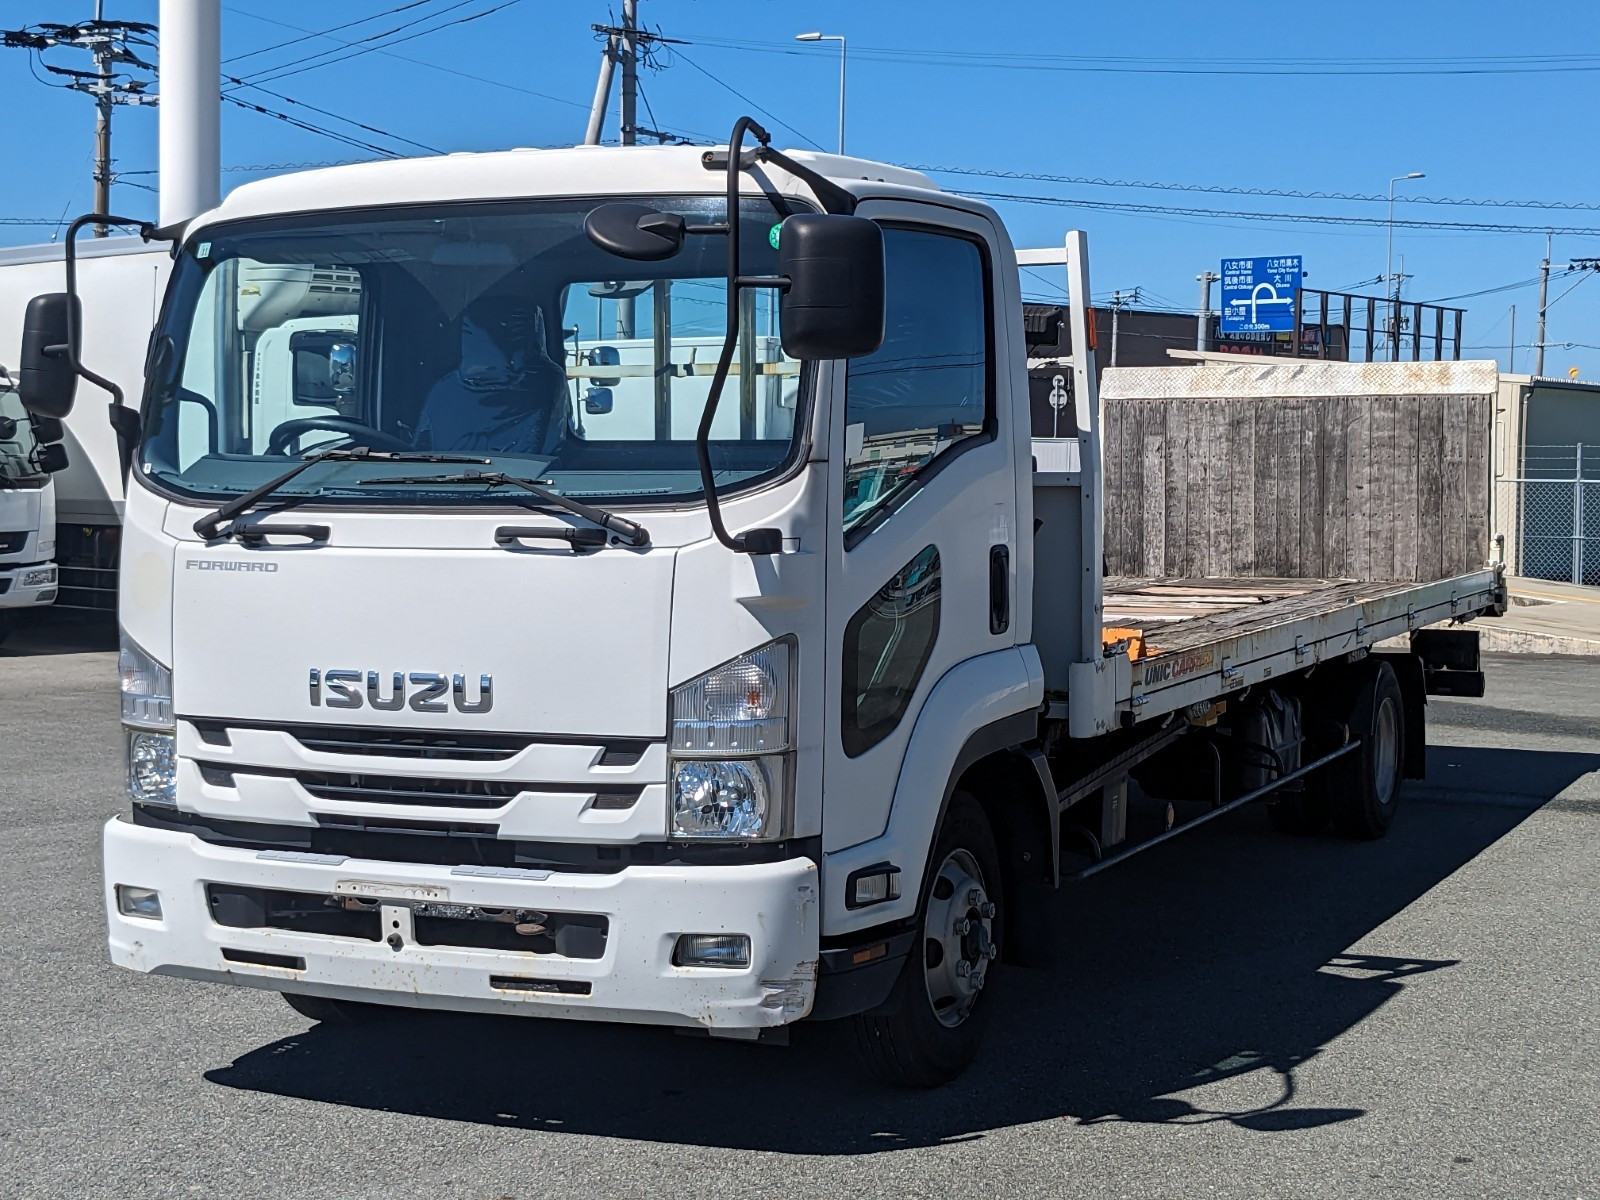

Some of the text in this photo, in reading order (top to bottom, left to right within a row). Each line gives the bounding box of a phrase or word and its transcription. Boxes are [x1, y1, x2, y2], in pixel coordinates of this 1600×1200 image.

[1224, 261, 1253, 270] 八女市街
[1267, 258, 1299, 268] 八女市黒木
[1224, 276, 1253, 285] 筑後市街
[1274, 274, 1292, 283] 大川
[1224, 306, 1246, 316] 船小屋
[185, 559, 279, 573] FORWARD
[1144, 662, 1171, 686] UNIC
[309, 667, 494, 714] ISUZU
